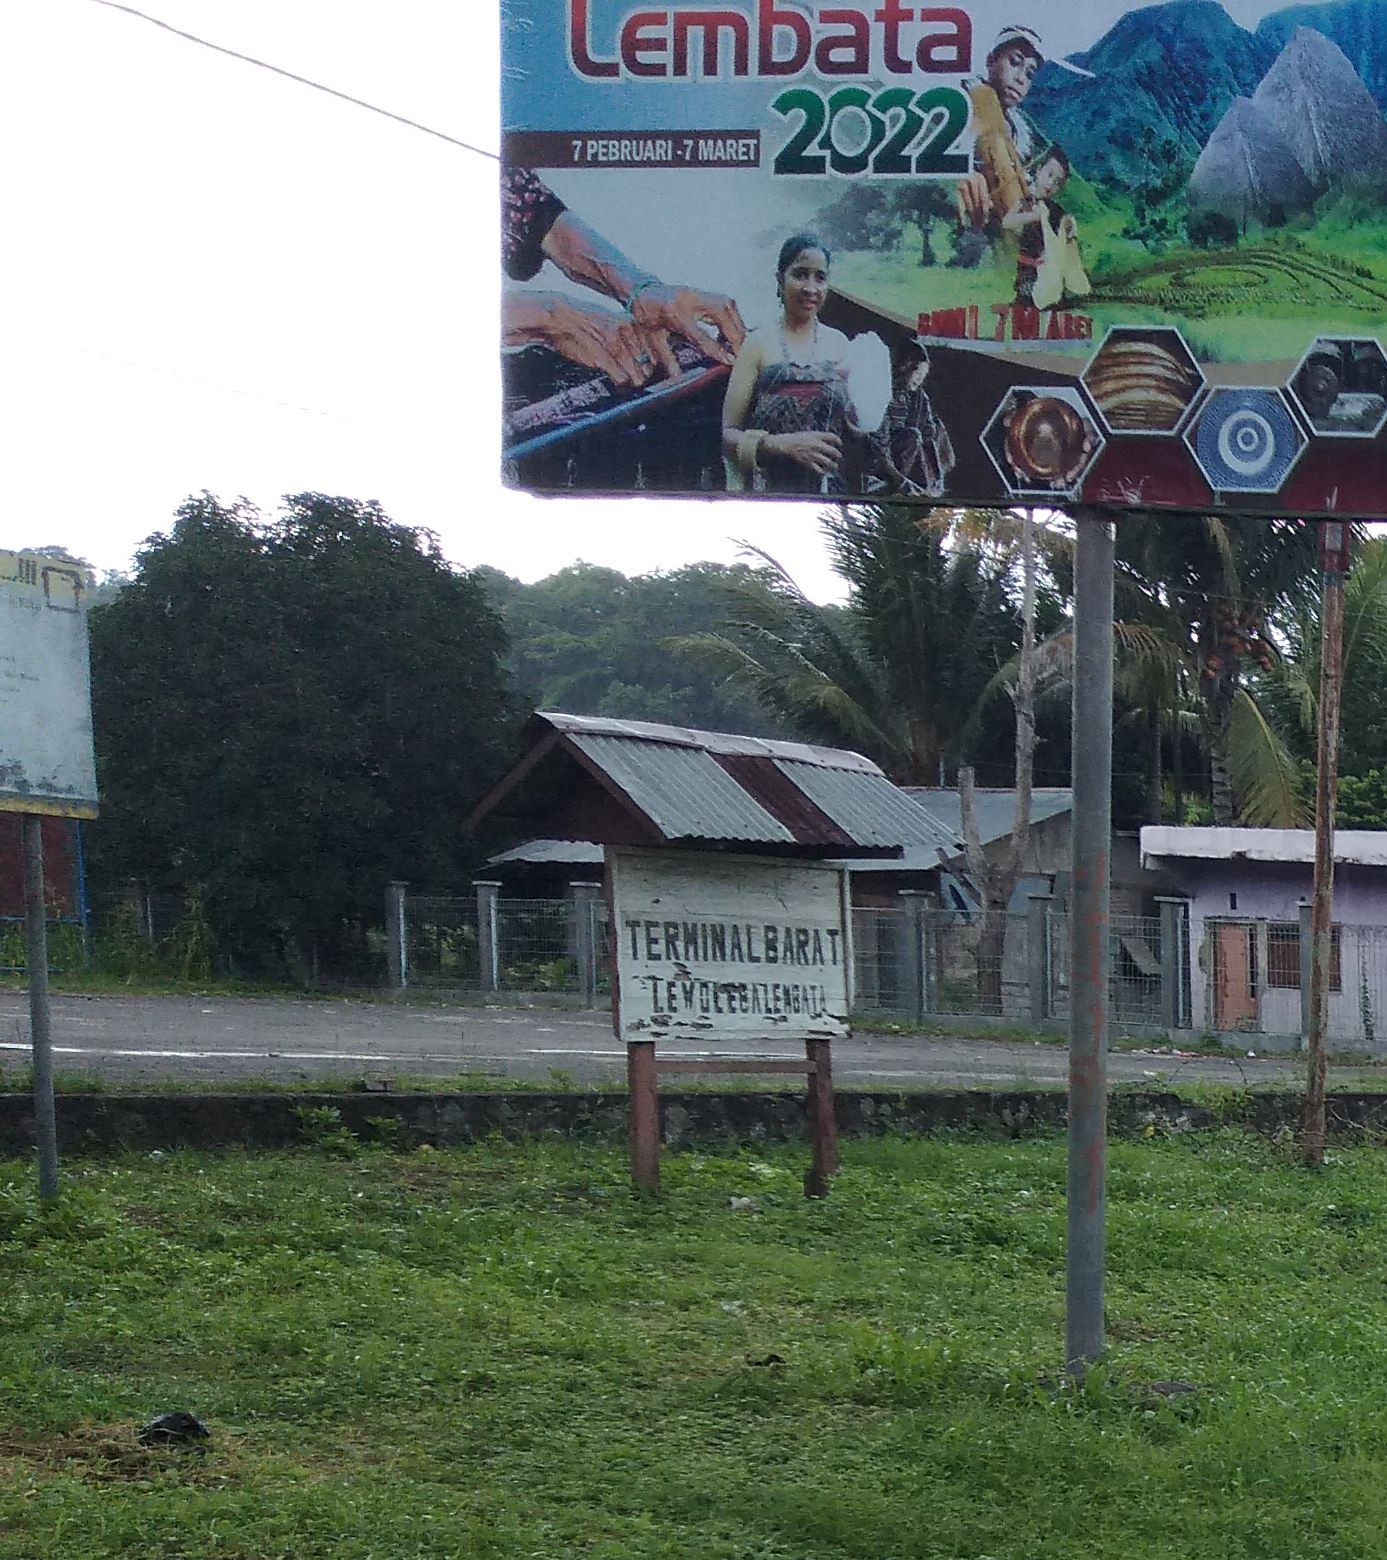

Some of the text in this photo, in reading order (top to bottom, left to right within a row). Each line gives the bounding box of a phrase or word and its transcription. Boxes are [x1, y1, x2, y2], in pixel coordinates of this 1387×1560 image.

[570, 0, 973, 78] Lembata
[571, 140, 583, 162] 7
[586, 140, 673, 162] PEBRUARI
[698, 138, 758, 161] MARET
[772, 86, 970, 175] 2022
[625, 920, 839, 966] TERMINAL BARAT
